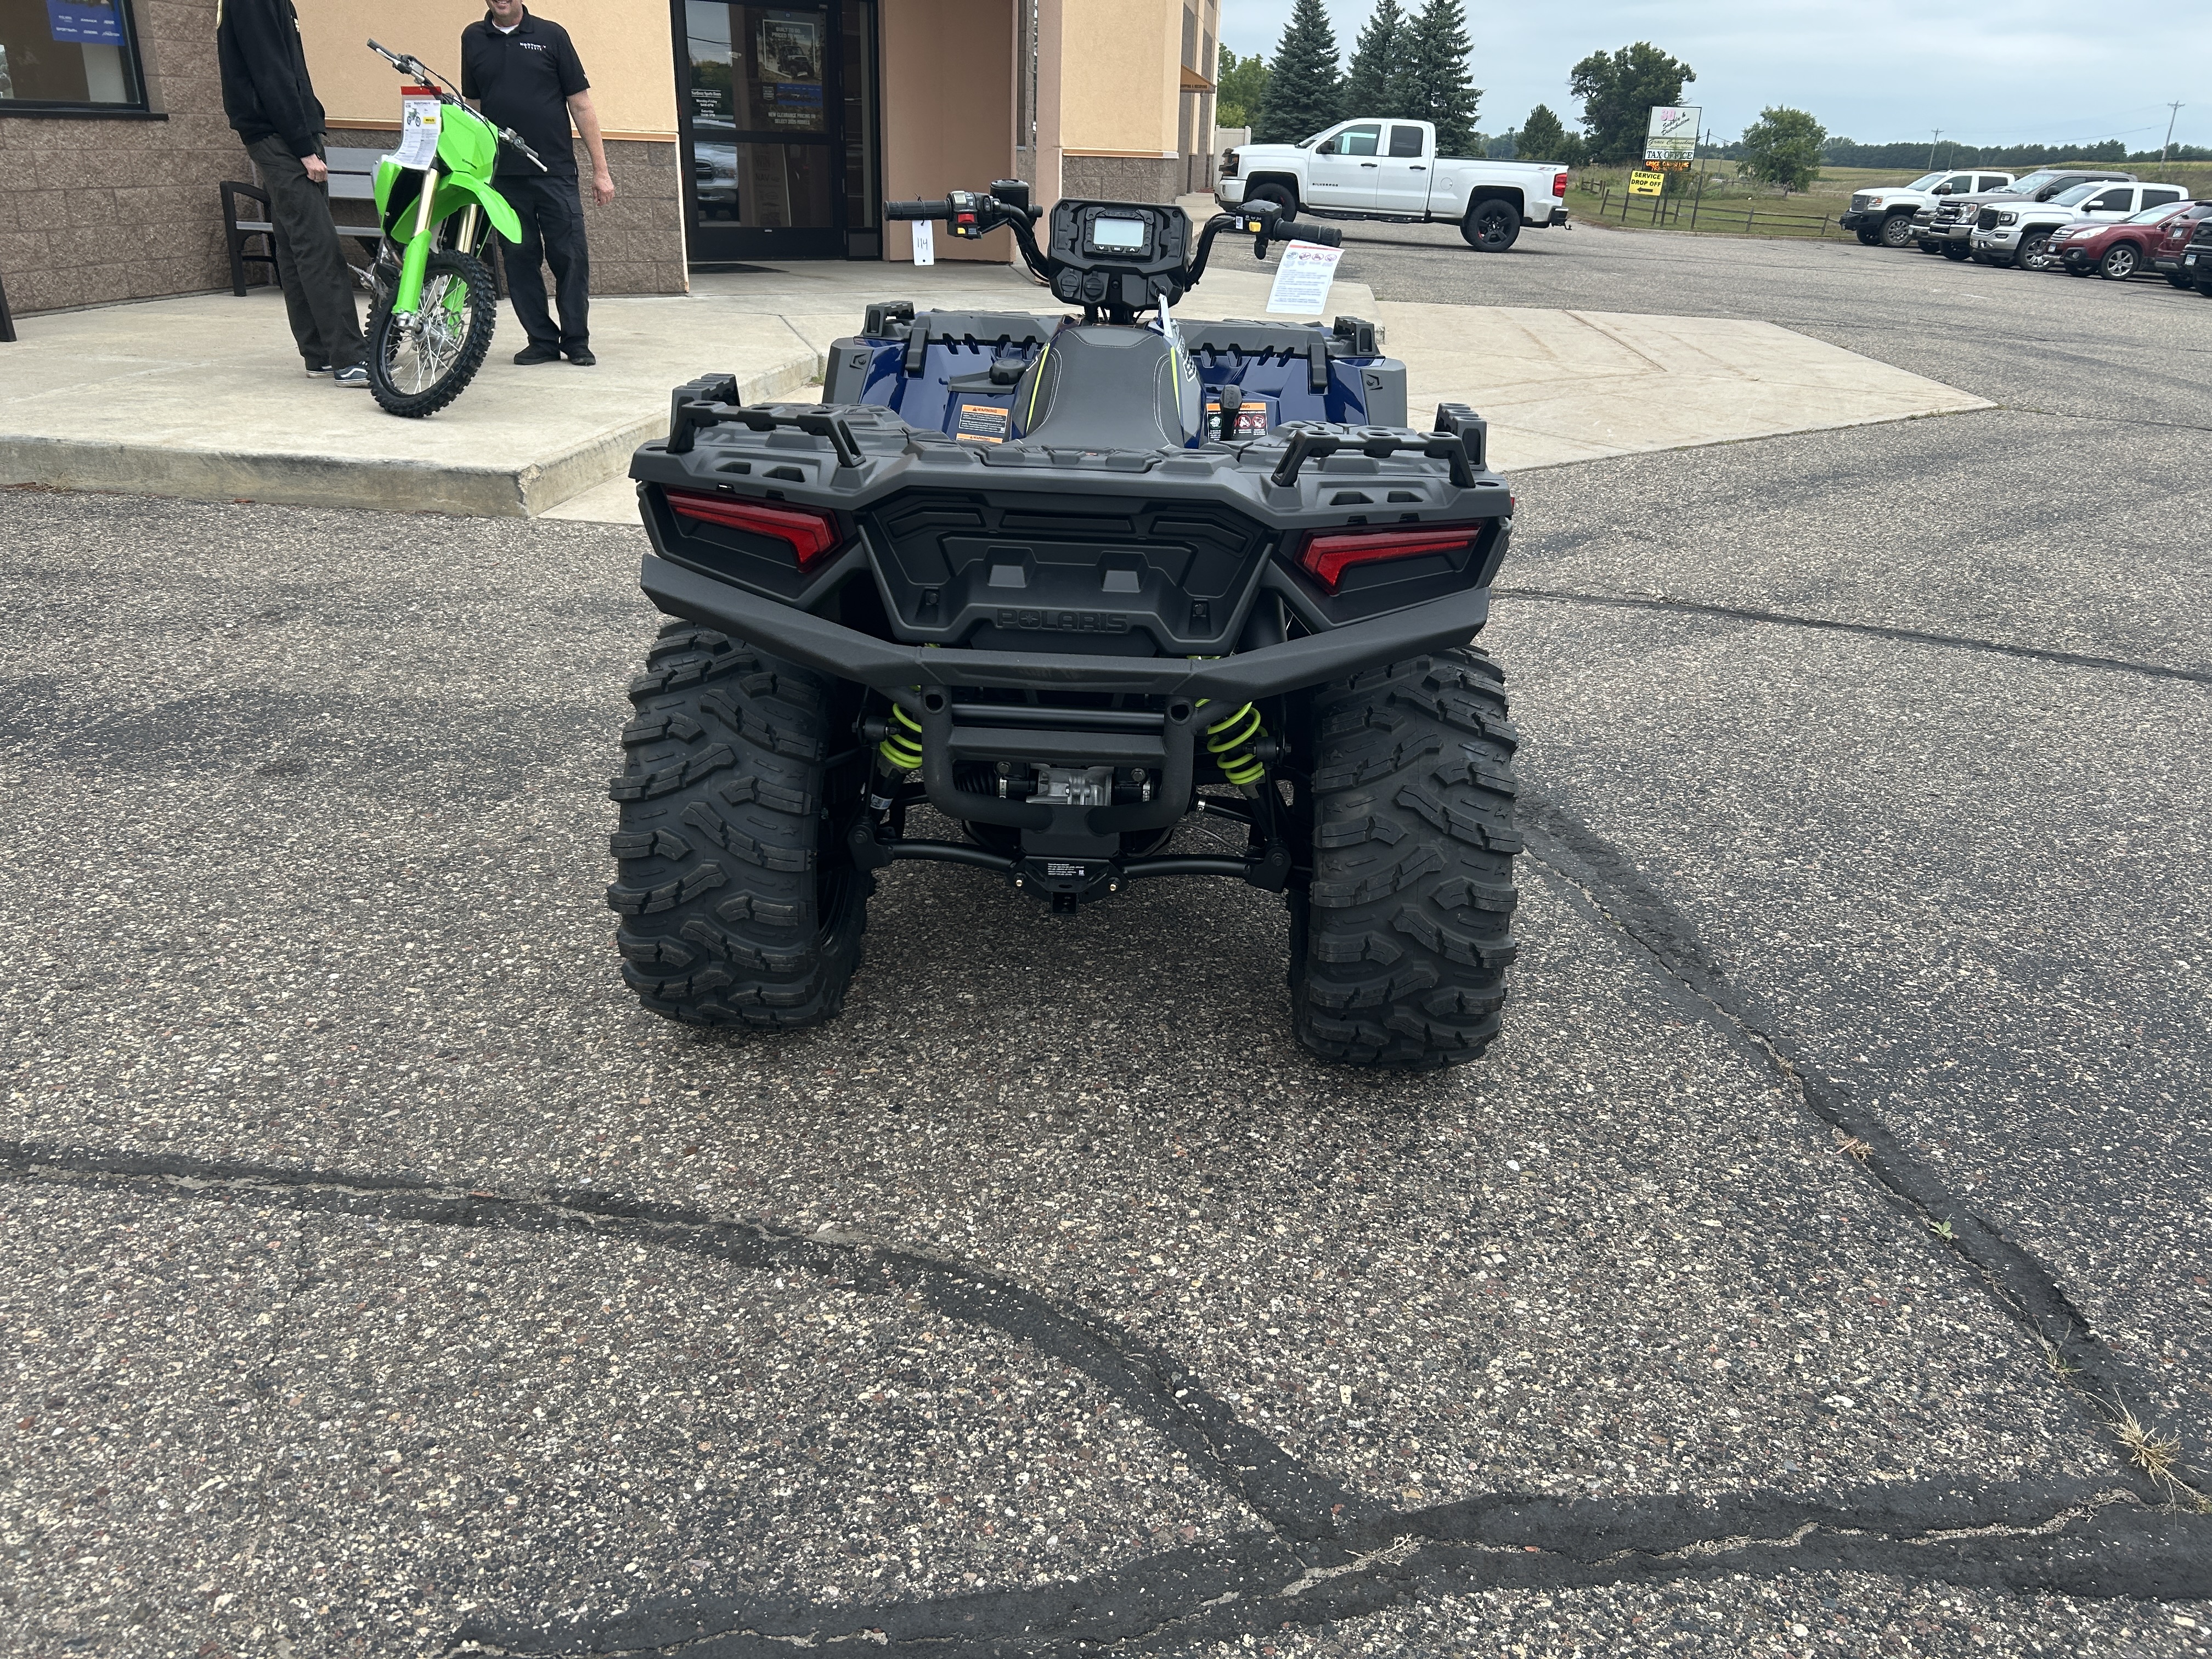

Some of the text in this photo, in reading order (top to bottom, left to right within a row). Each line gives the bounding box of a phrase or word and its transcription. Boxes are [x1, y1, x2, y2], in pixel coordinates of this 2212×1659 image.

[1661, 109, 1675, 121] 3D
[1661, 117, 1690, 136] Distribution
[1663, 117, 1680, 129] Supply
[917, 237, 928, 250] 114
[997, 609, 1128, 633] POLARIS
